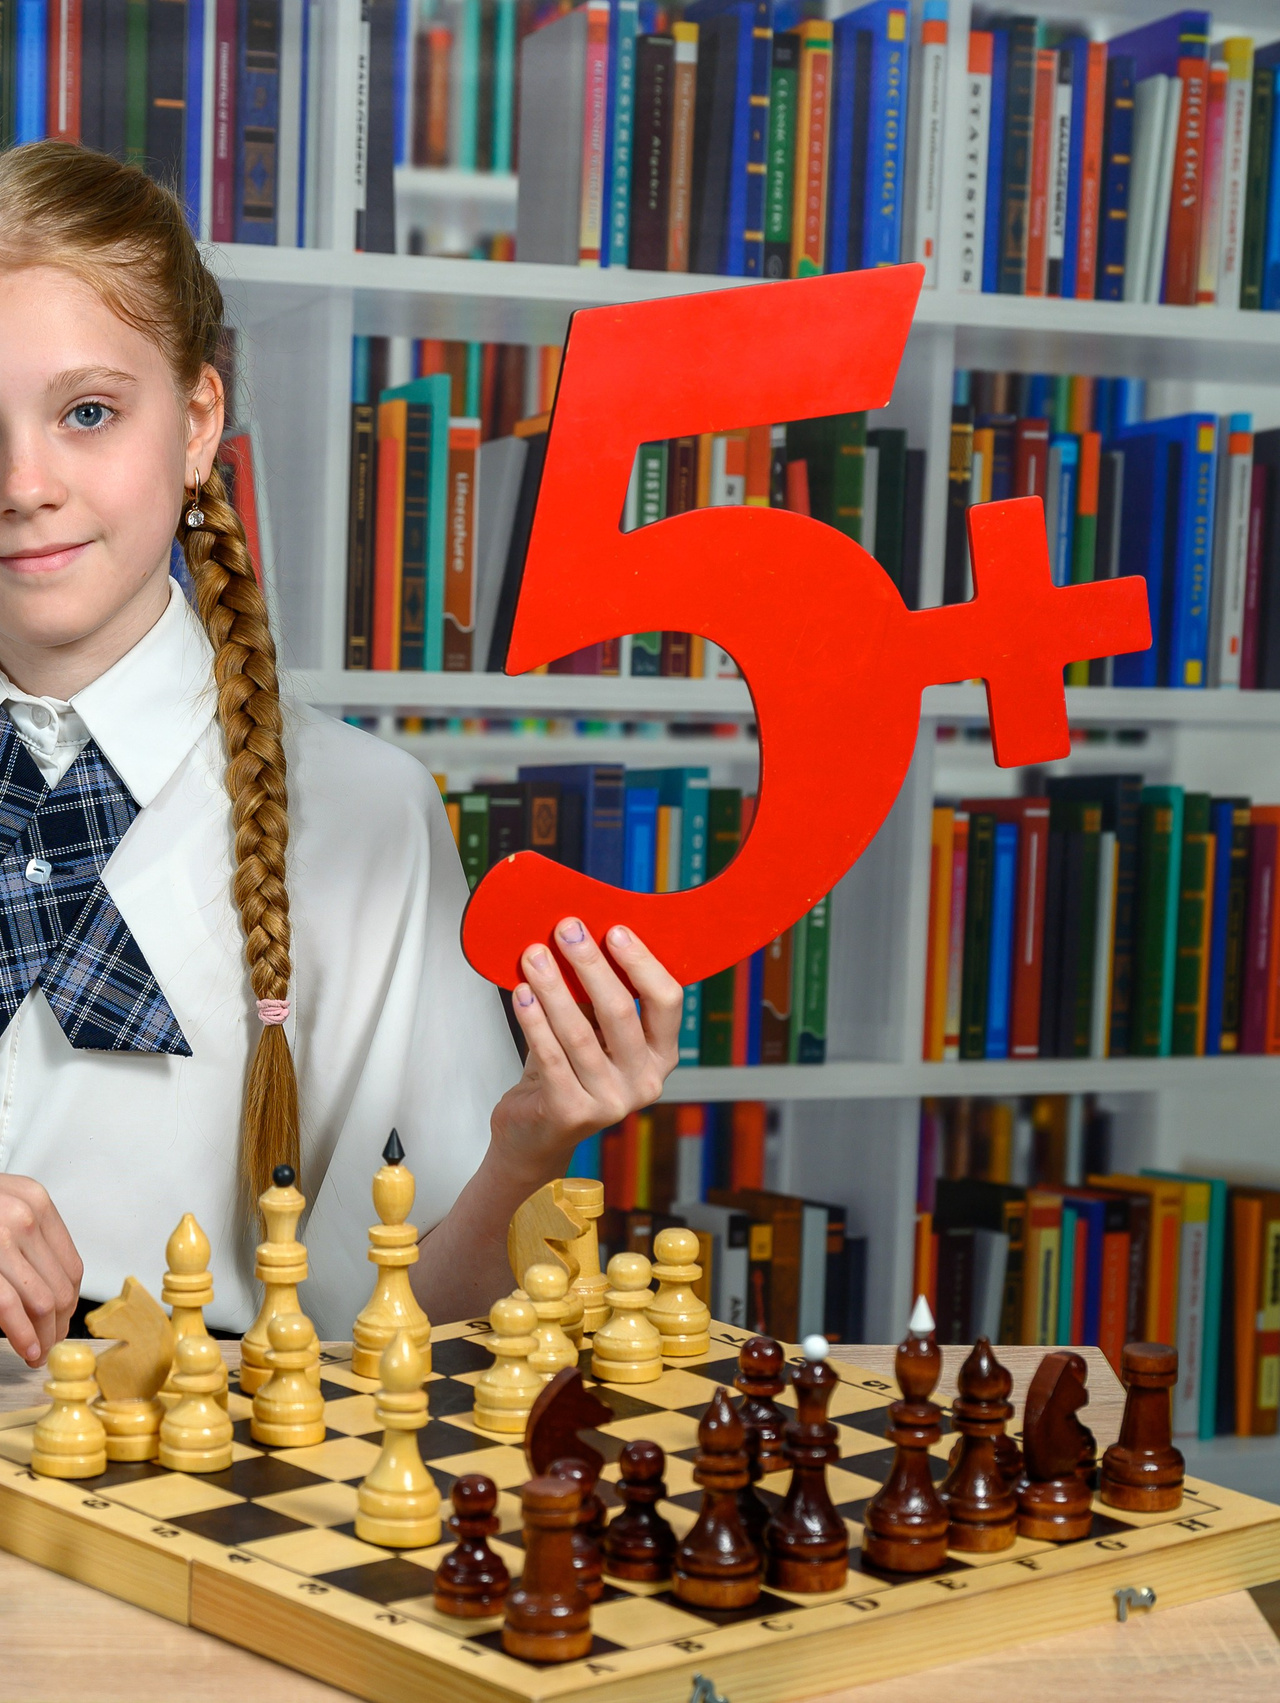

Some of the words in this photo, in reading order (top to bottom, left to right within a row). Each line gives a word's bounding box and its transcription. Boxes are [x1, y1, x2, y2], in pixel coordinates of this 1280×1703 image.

[614, 37, 633, 247] CONSTRUCTION
[962, 82, 982, 284] STATISTICS
[453, 472, 470, 573] Literature
[151, 1524, 182, 1539] 5
[226, 1552, 257, 1566] 4
[297, 1581, 330, 1596] 3
[584, 1662, 619, 1677] A
[671, 1639, 706, 1655] B
[760, 1618, 795, 1633] C
[842, 1599, 882, 1613] D
[937, 1578, 970, 1592] E
[1013, 1558, 1044, 1573] F
[1094, 1539, 1129, 1552] G
[1171, 1518, 1214, 1534] H
[374, 1613, 408, 1627] 2
